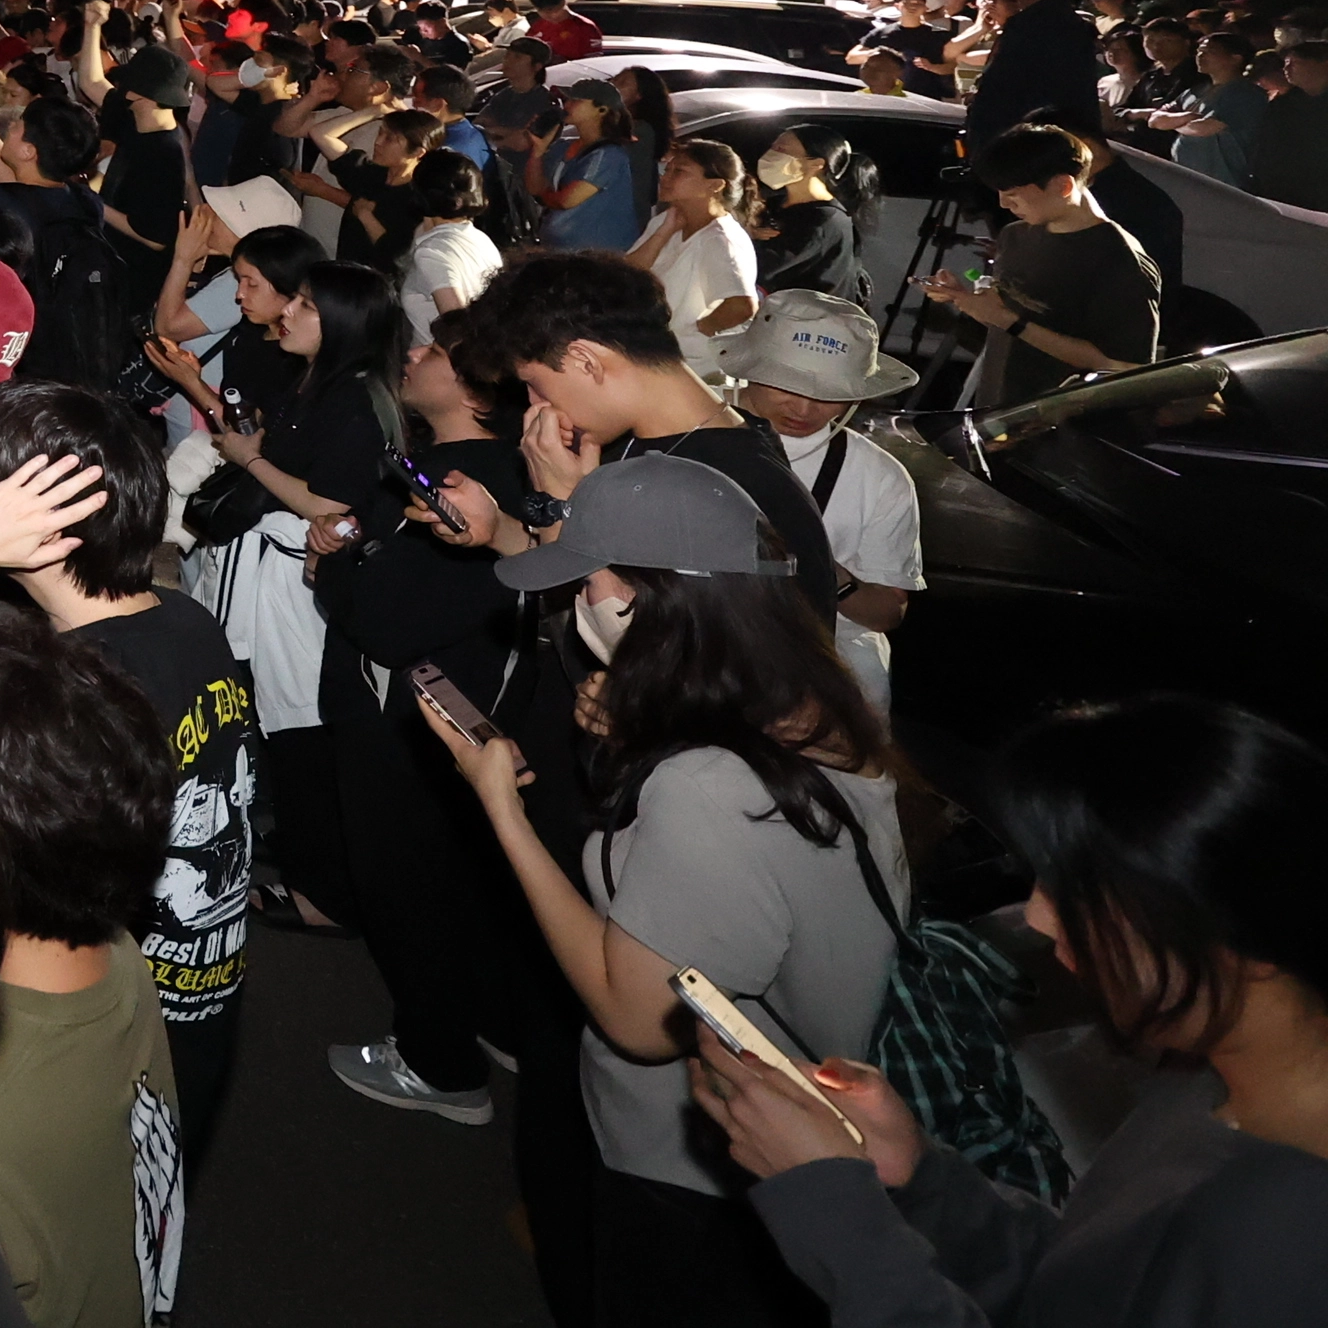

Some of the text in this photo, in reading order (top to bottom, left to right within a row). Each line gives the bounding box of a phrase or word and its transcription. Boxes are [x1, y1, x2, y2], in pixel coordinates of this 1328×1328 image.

[792, 332, 848, 353] AIR FORCE
[141, 932, 202, 966] Best
[158, 989, 181, 1003] THE
[180, 995, 202, 1004] ART
